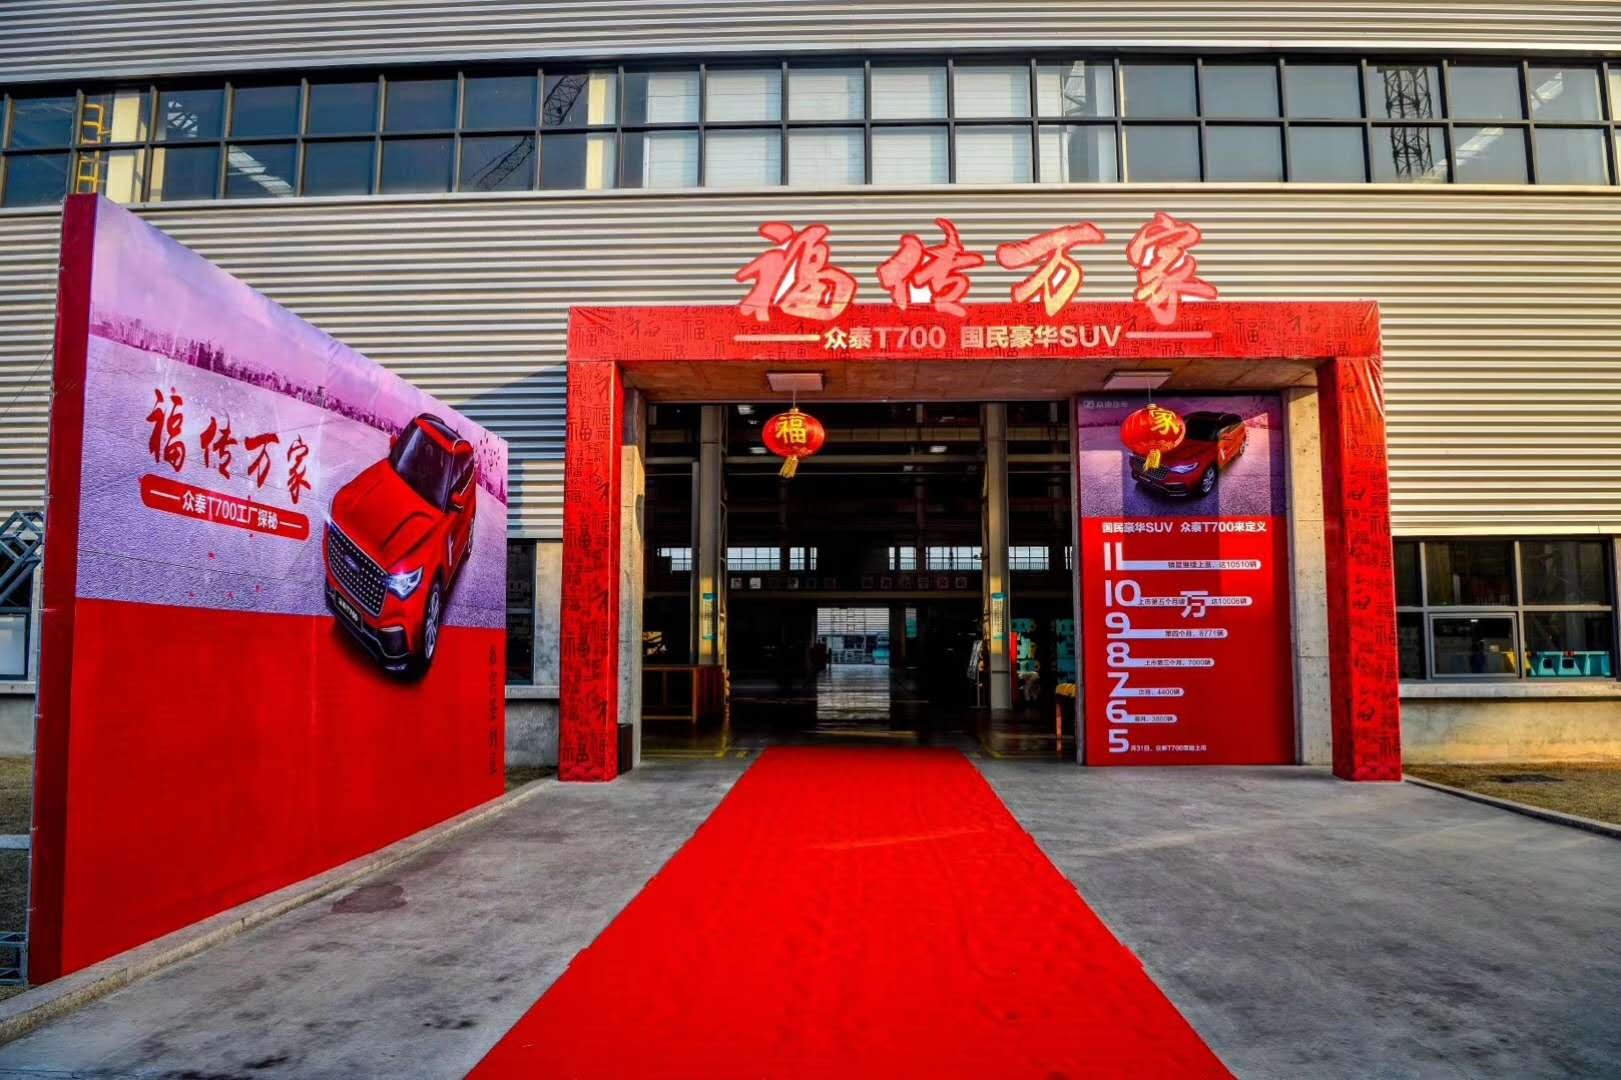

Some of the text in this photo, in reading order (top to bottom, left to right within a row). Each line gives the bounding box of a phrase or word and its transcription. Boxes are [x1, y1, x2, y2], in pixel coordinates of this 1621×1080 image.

[735, 210, 1218, 325] 福传万家
[824, 325, 1122, 349] 众泰T700 国民豪华SUV
[776, 415, 808, 444] 福
[1148, 409, 1180, 435] 家
[146, 388, 311, 504] 福传万家
[182, 490, 278, 530] 众泰T700工厂探秘
[1102, 521, 1267, 533] 国民豪华SUV 众泰T700来定义
[1105, 580, 1141, 606] 10
[1180, 590, 1208, 618] 万
[1105, 612, 1130, 638] 9
[1106, 642, 1130, 667] 8
[1107, 672, 1129, 697] 7
[1106, 700, 1128, 723] 6
[1108, 729, 1129, 752] 5
